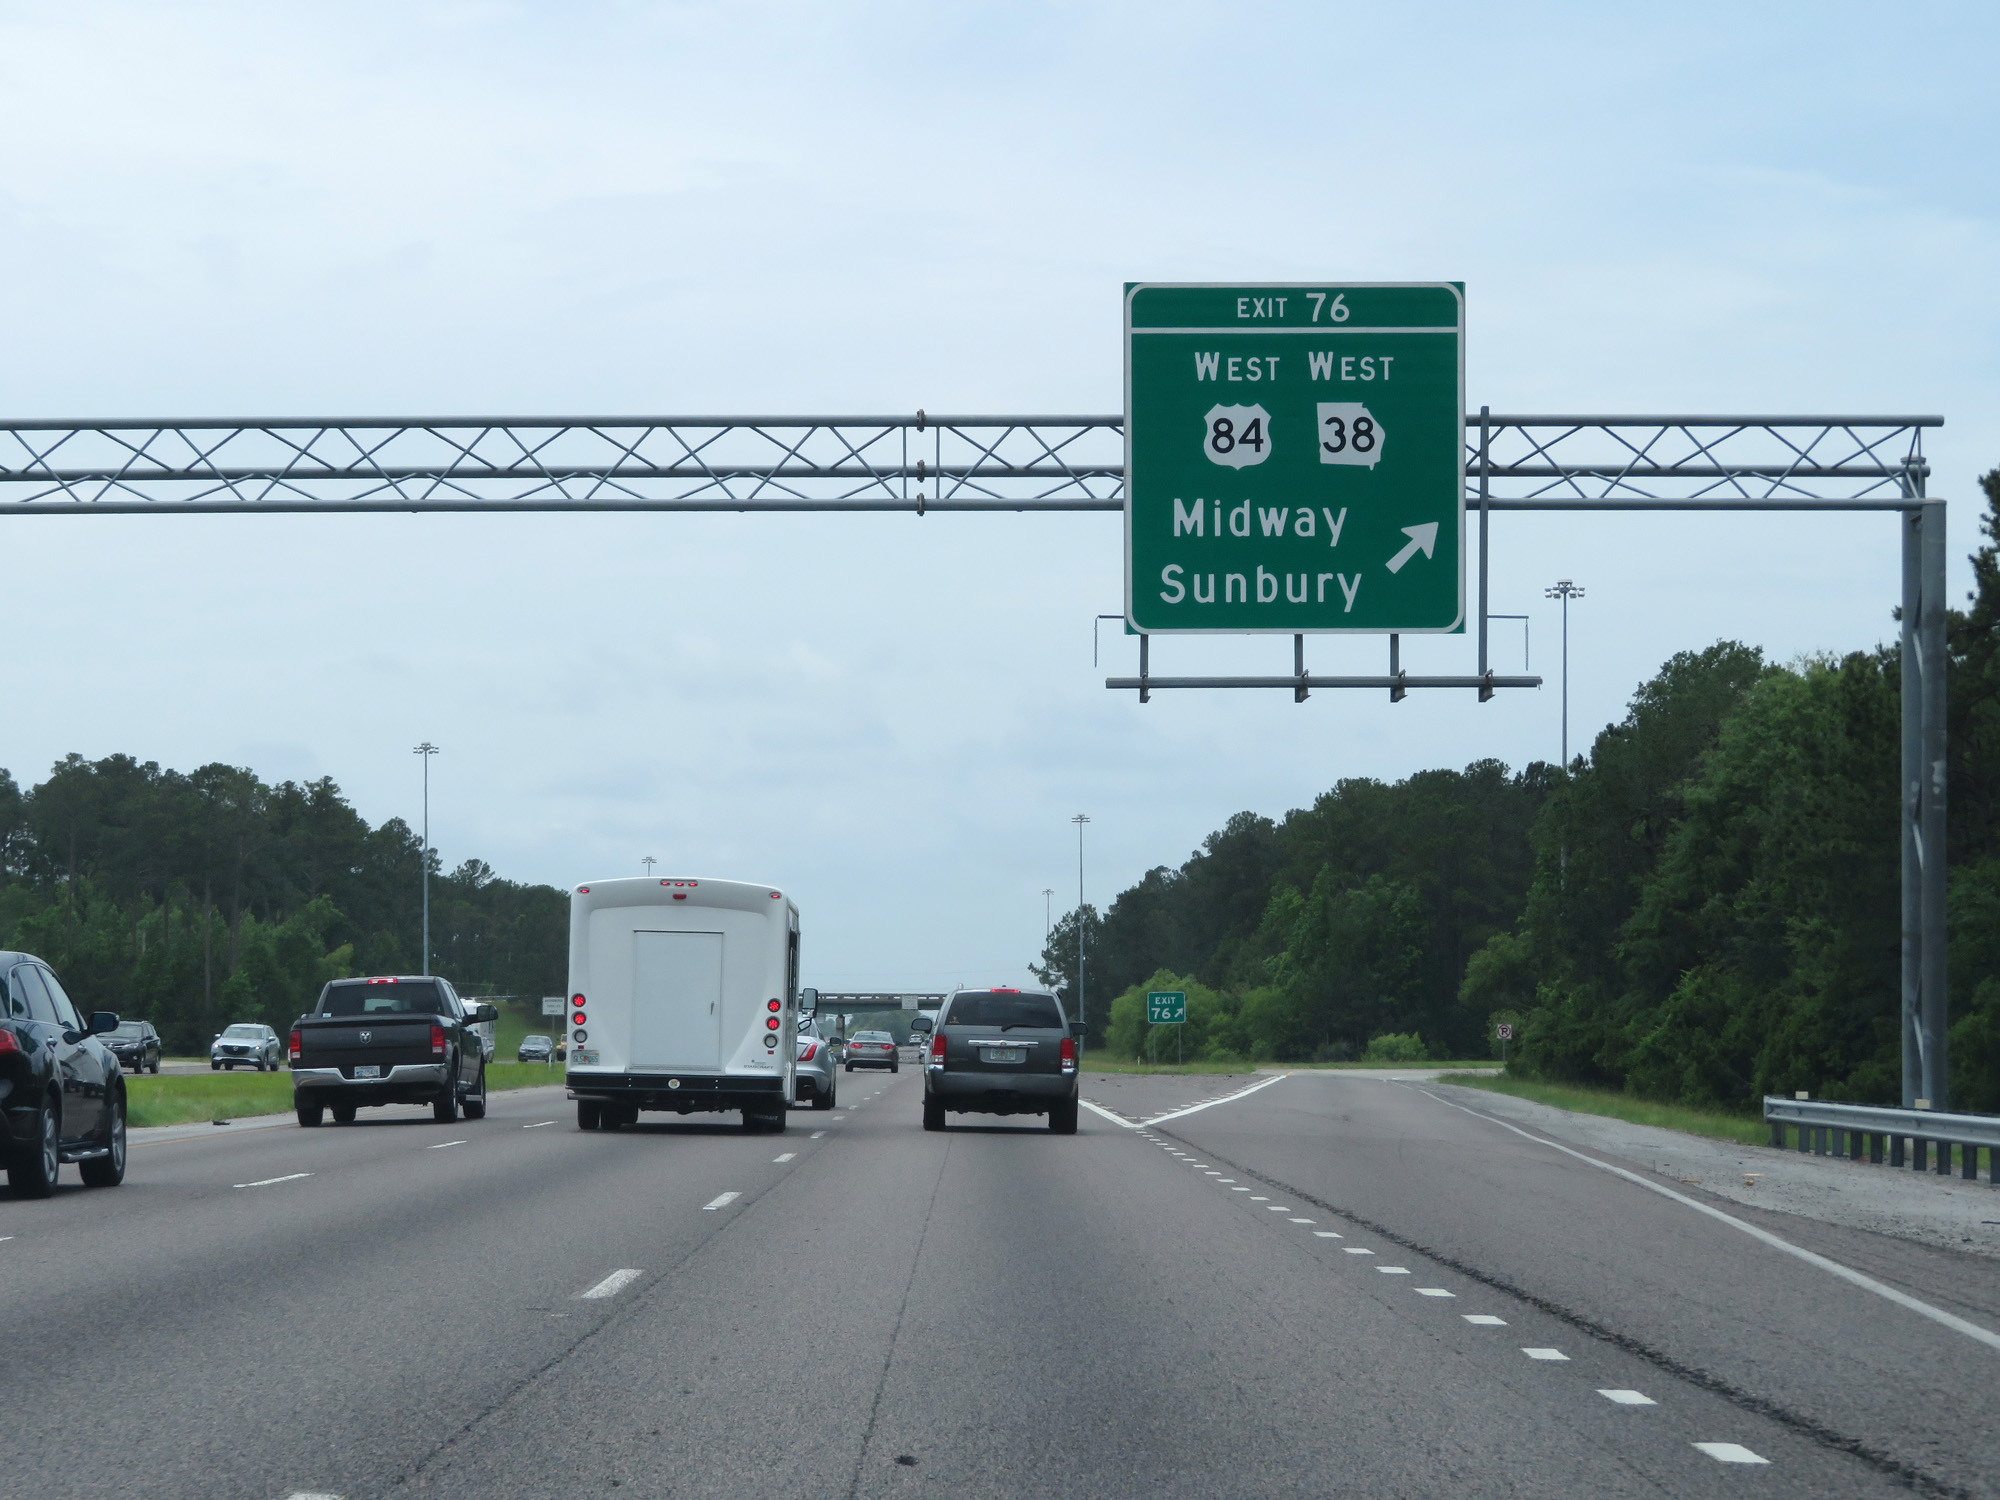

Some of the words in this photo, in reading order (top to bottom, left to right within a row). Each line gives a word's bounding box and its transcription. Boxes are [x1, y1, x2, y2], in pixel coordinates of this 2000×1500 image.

[1237, 297, 1288, 318] EXIT
[1306, 293, 1350, 323] 76
[1194, 351, 1281, 381] WEST
[1308, 351, 1394, 381] WEST
[1211, 417, 1264, 454] 84
[1322, 416, 1376, 453] 38
[1173, 498, 1348, 547] Midway
[1160, 563, 1362, 613] Sunbury
[1152, 1008, 1171, 1019] 76
[1156, 997, 1175, 1005] EXIT
